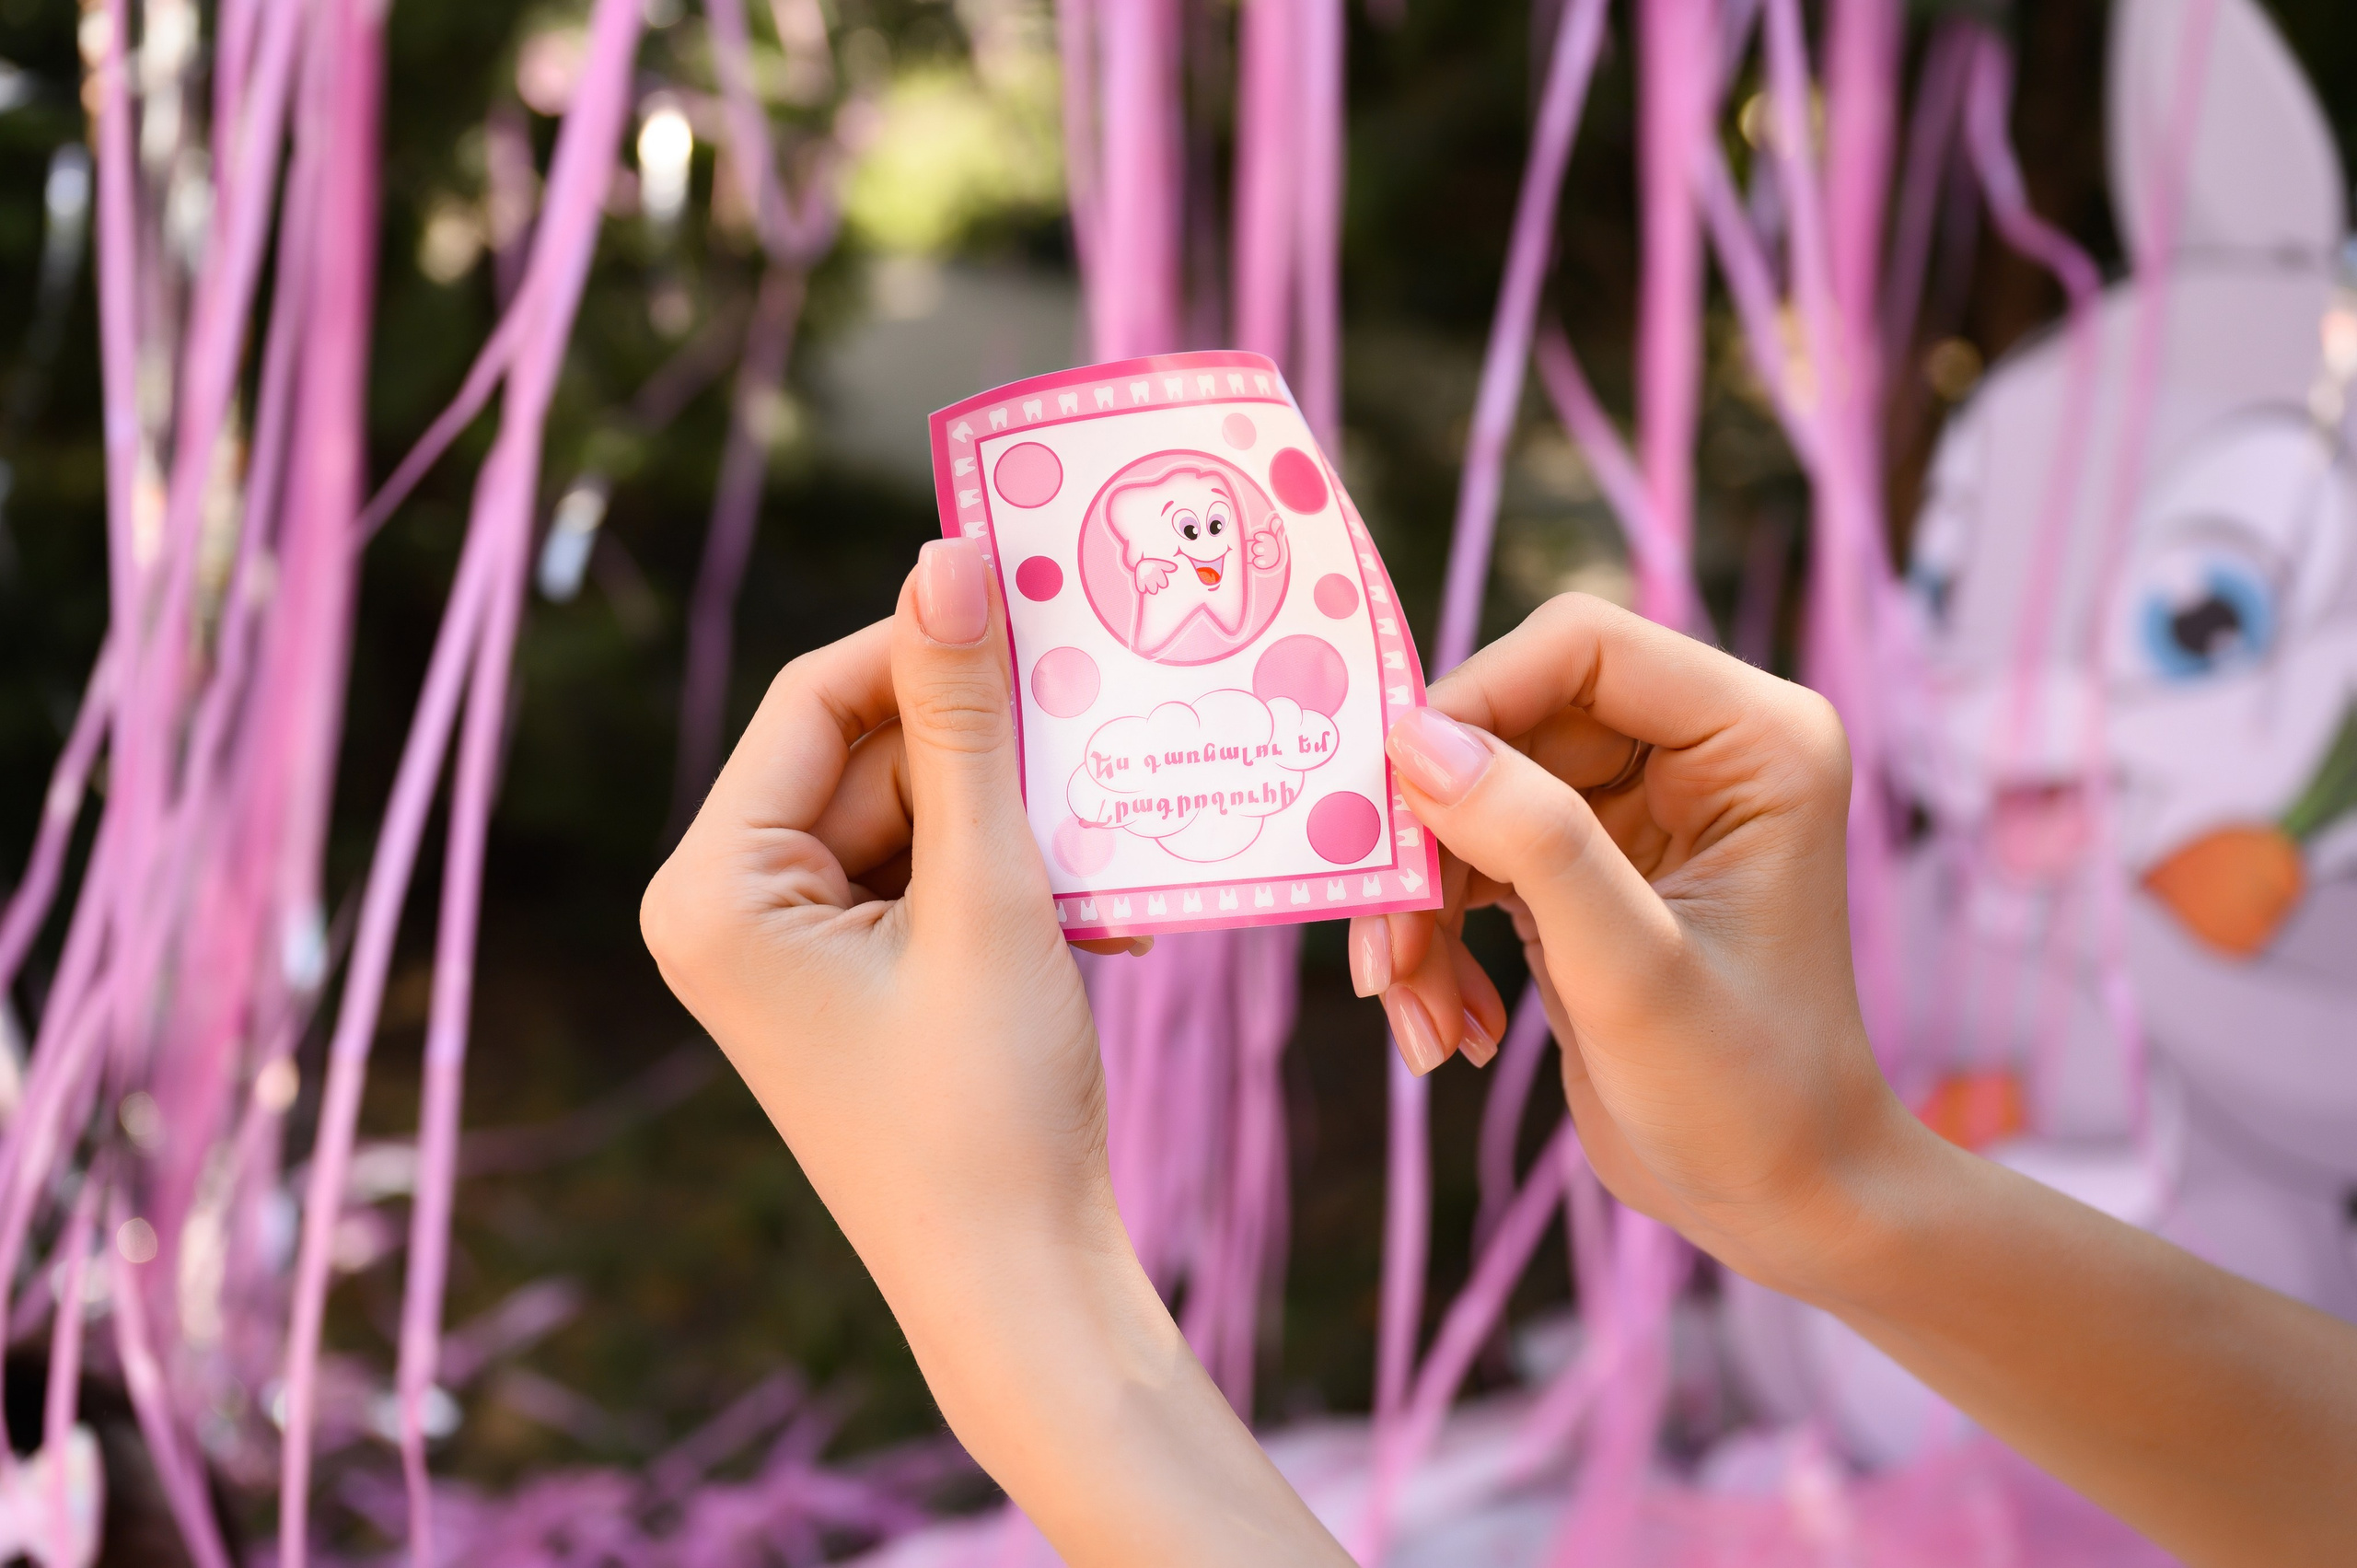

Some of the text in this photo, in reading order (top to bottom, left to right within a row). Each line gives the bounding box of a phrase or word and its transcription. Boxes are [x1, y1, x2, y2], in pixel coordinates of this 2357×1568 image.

[1090, 730, 1330, 780] Ես դառնալու եմ
